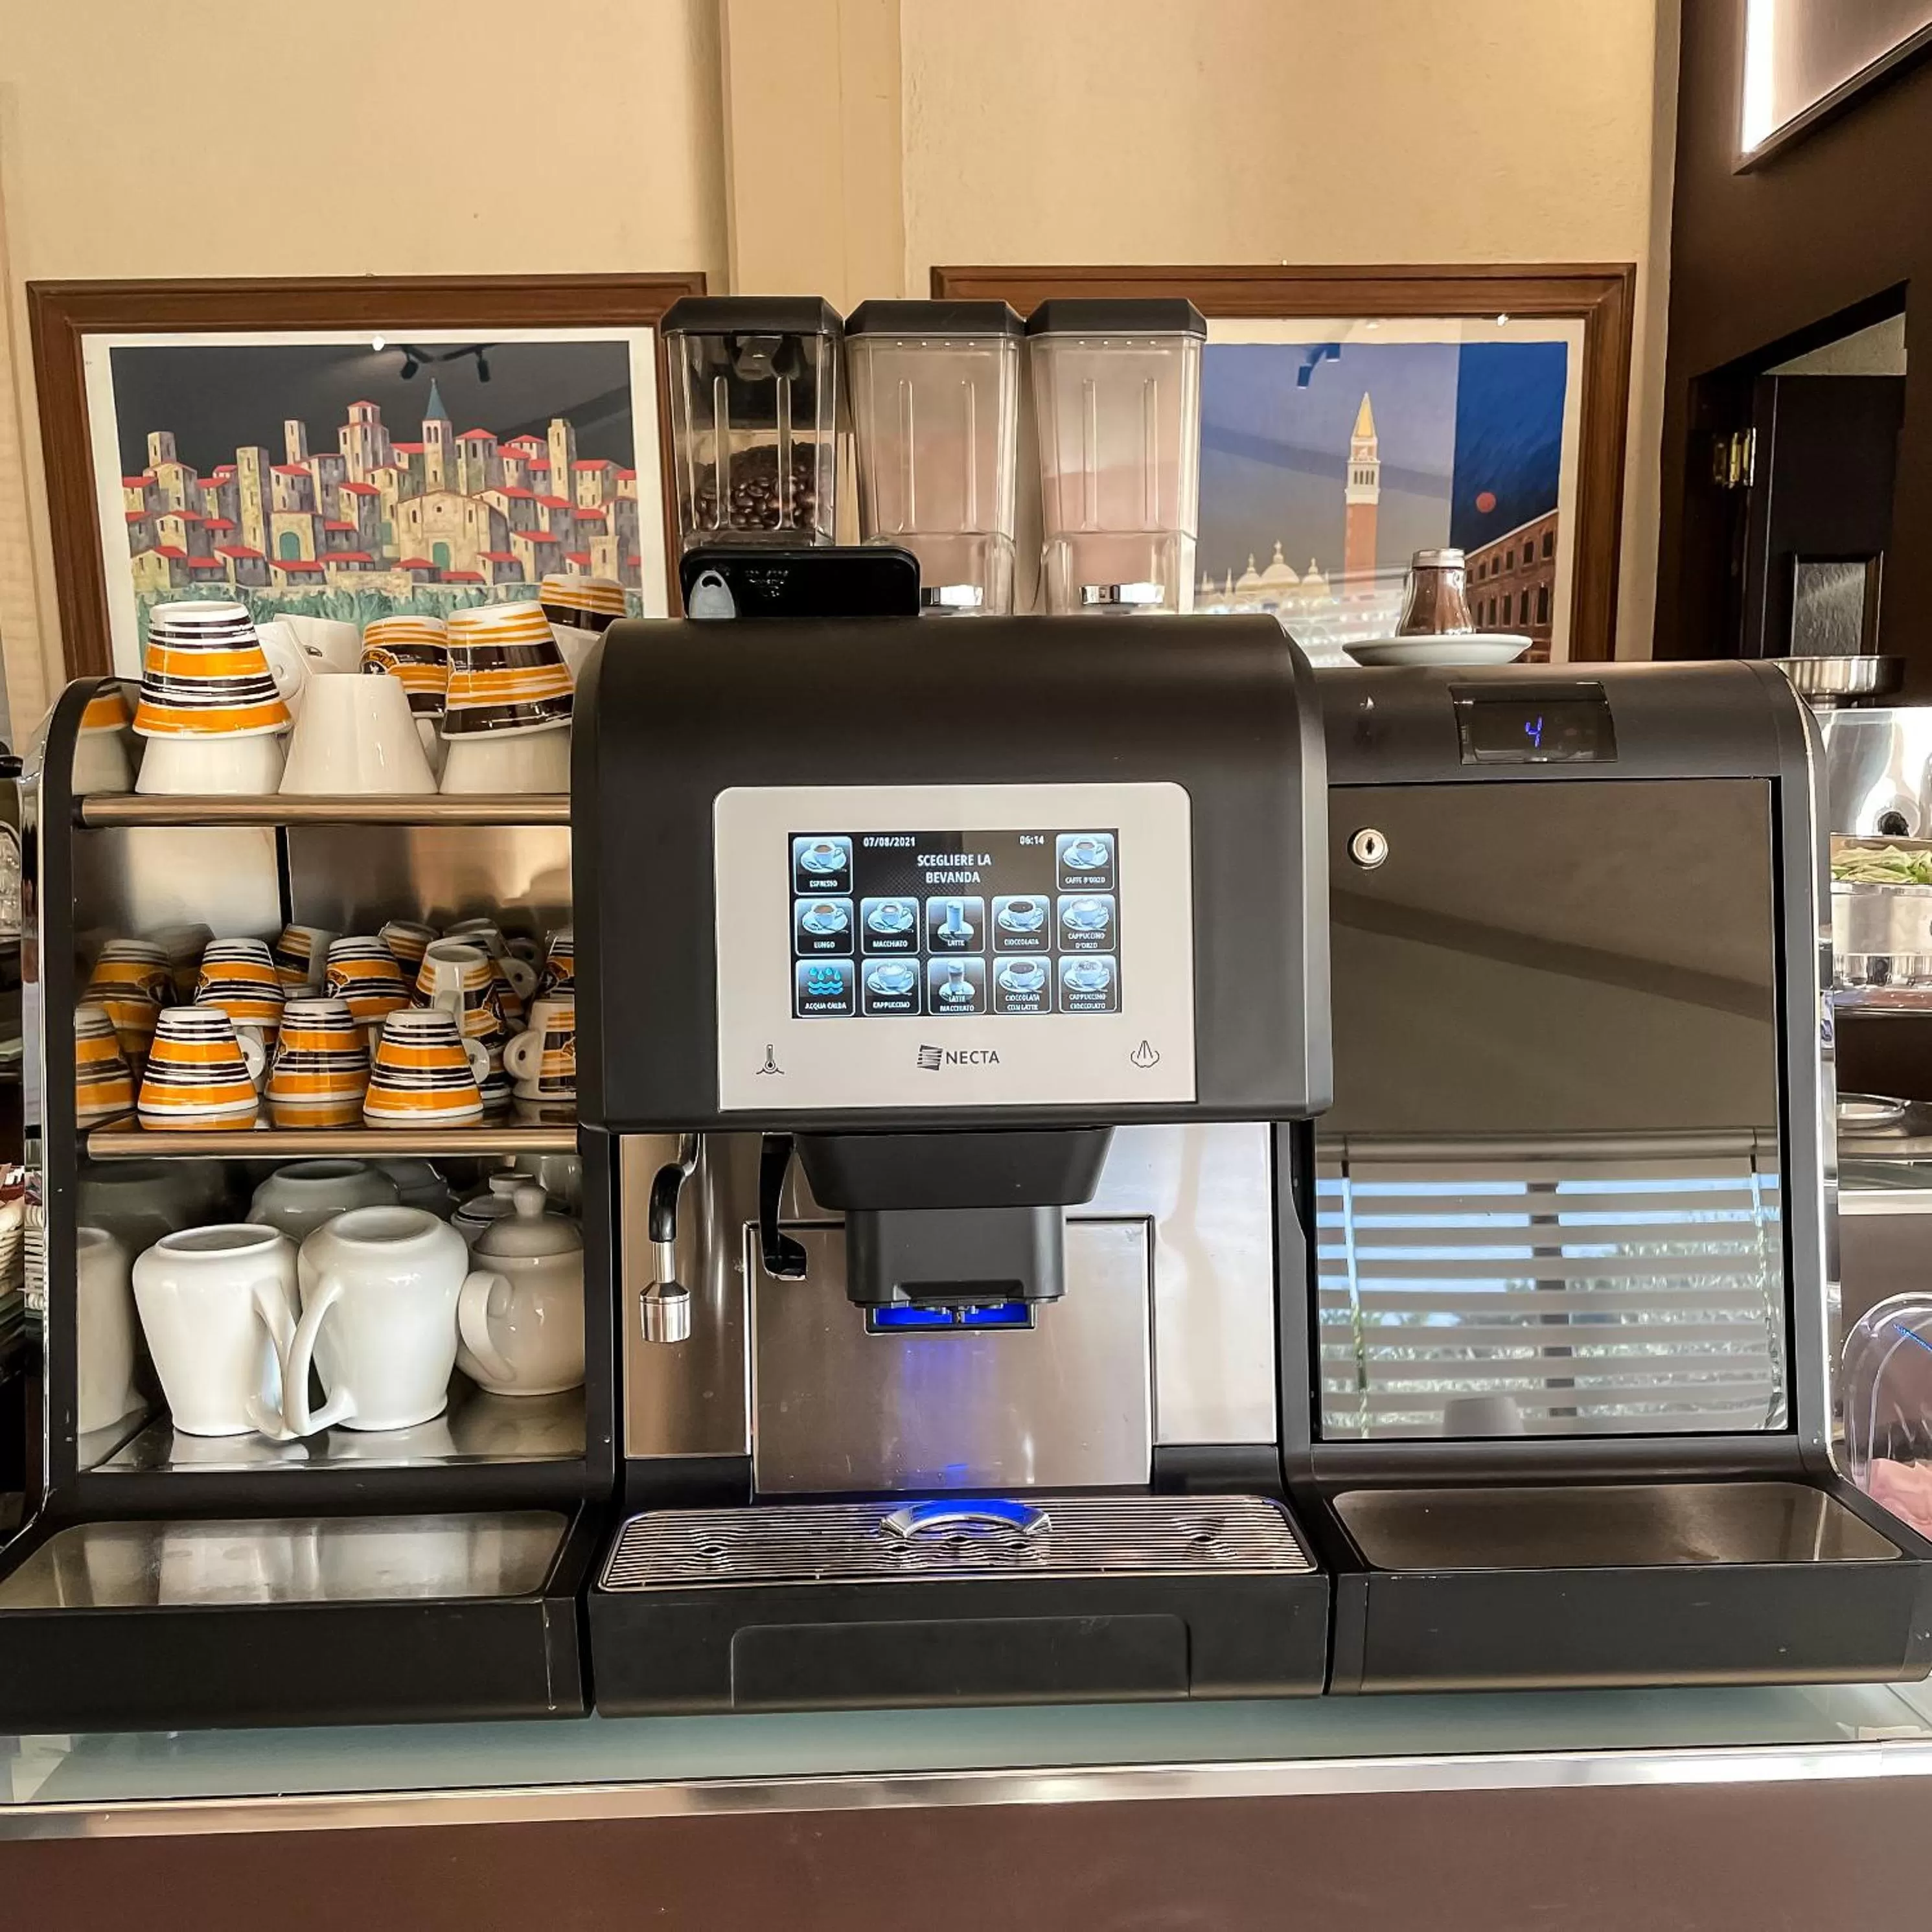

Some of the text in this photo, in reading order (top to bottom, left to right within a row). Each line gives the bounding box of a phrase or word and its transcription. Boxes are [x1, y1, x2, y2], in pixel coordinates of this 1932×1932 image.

[1525, 715, 1543, 748] 4
[1019, 835, 1044, 845] 06:14
[917, 854, 991, 866] SCEGLIERE LA
[926, 871, 980, 883] BEVANDA
[946, 1050, 1000, 1064] NECTA
